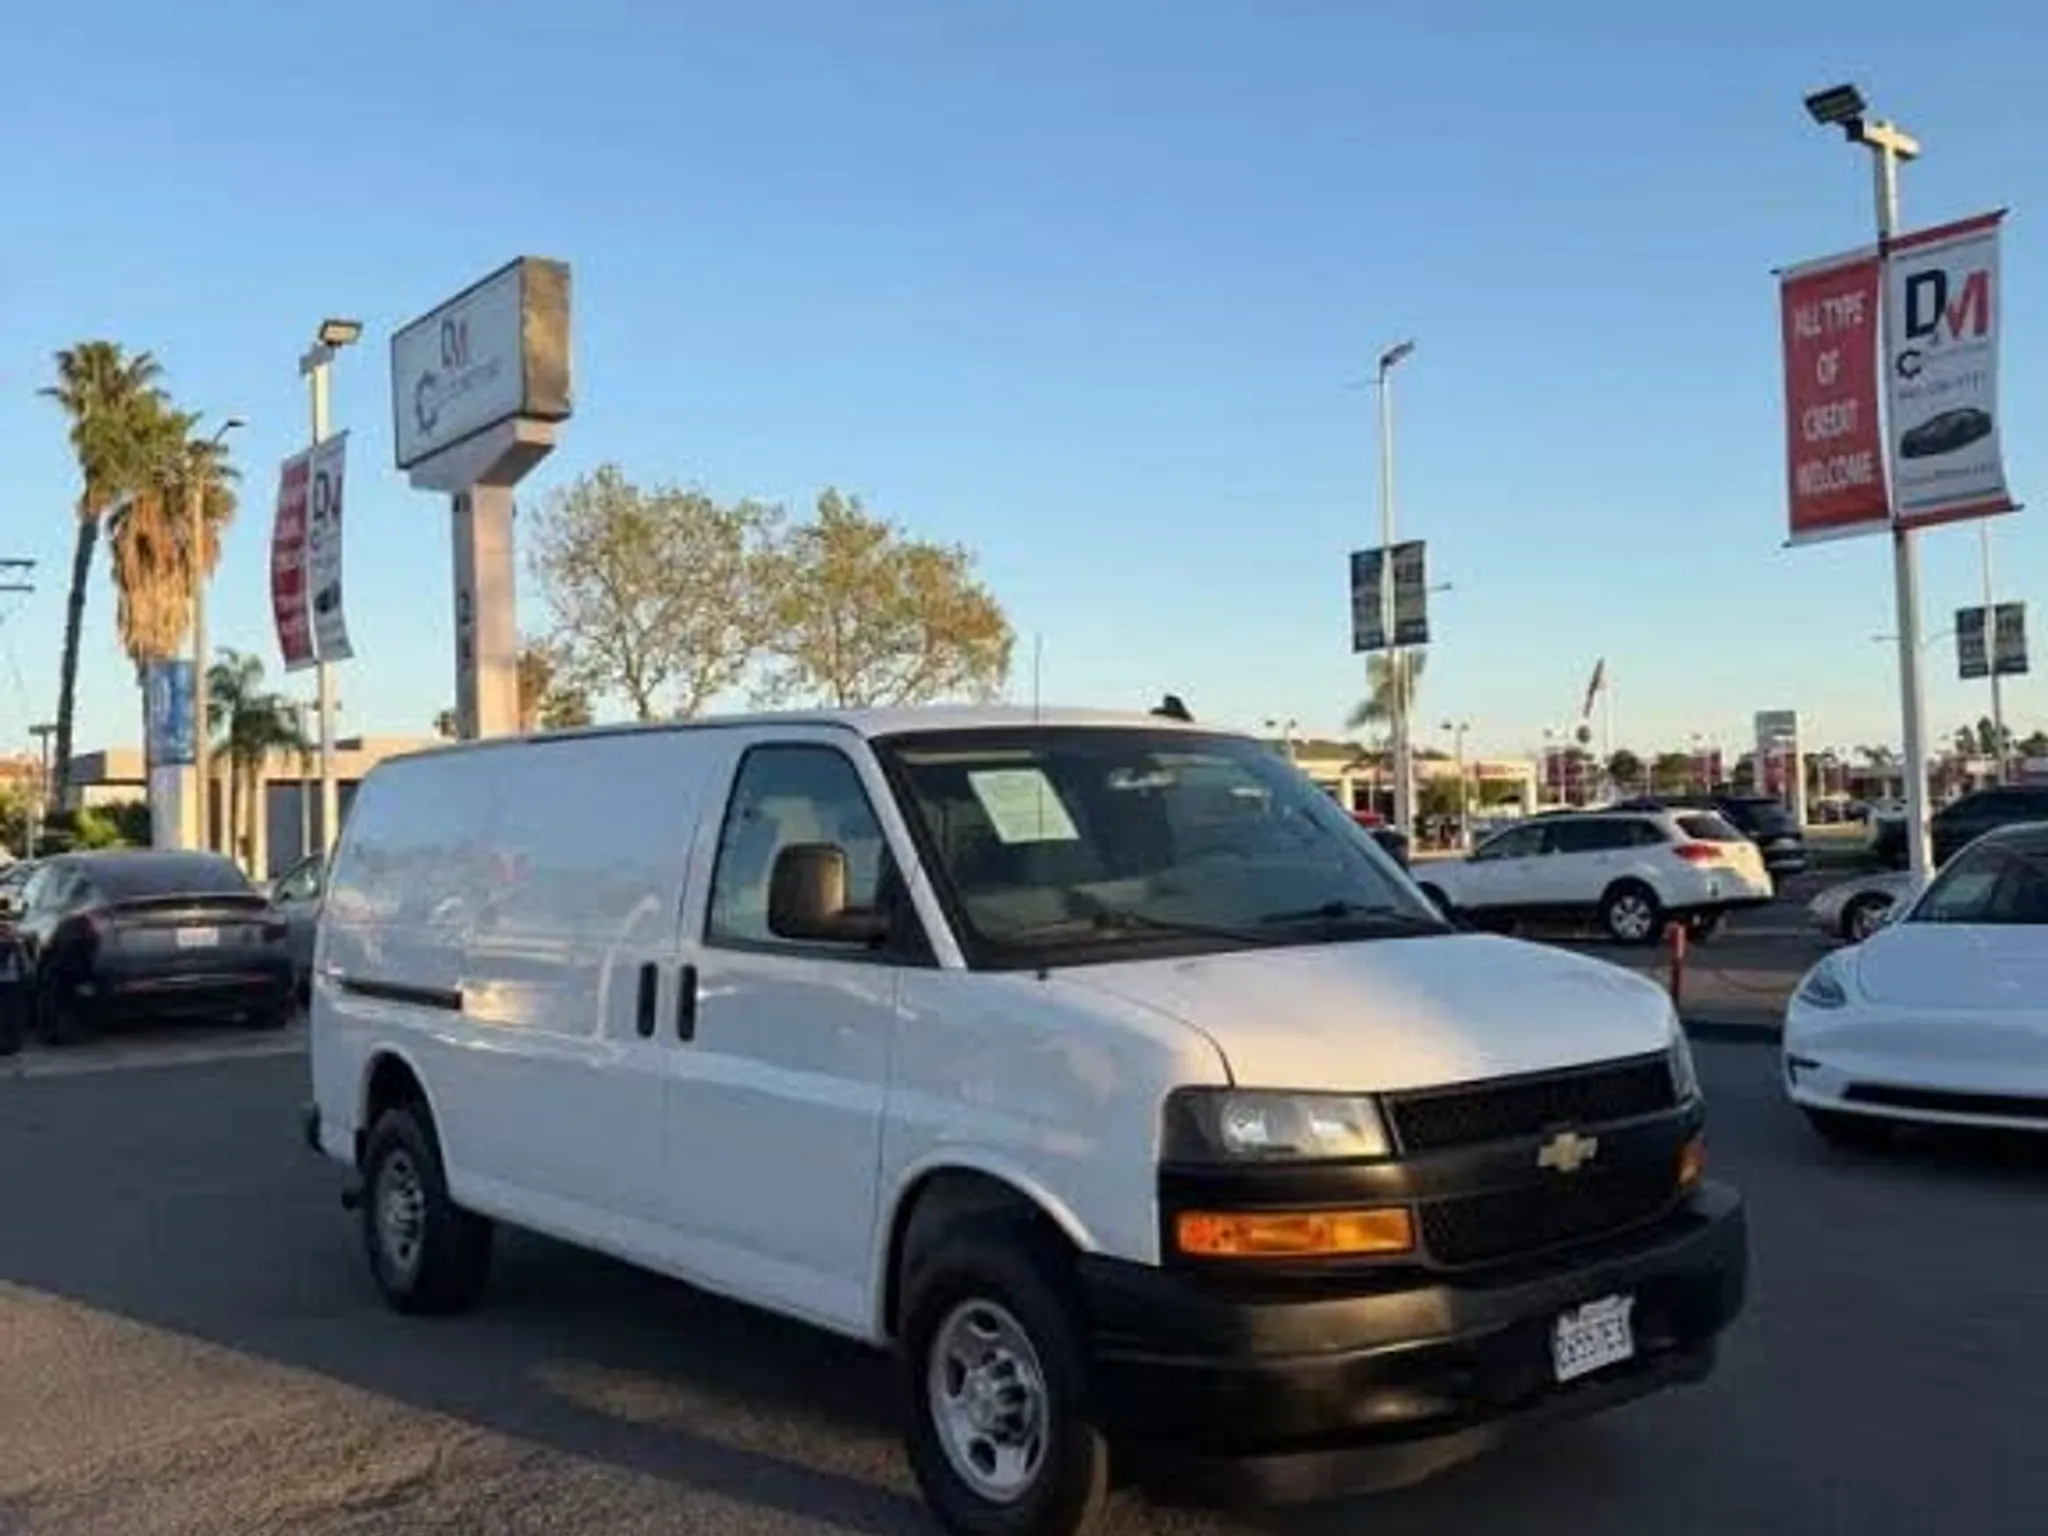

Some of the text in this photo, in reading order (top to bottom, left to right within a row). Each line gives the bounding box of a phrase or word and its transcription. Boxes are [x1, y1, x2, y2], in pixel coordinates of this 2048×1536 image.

[1795, 289, 1866, 338] ALL TYPE
[1816, 349, 1841, 386] OF
[1802, 398, 1859, 442] CREDIT
[1797, 450, 1875, 496] WELCOME
